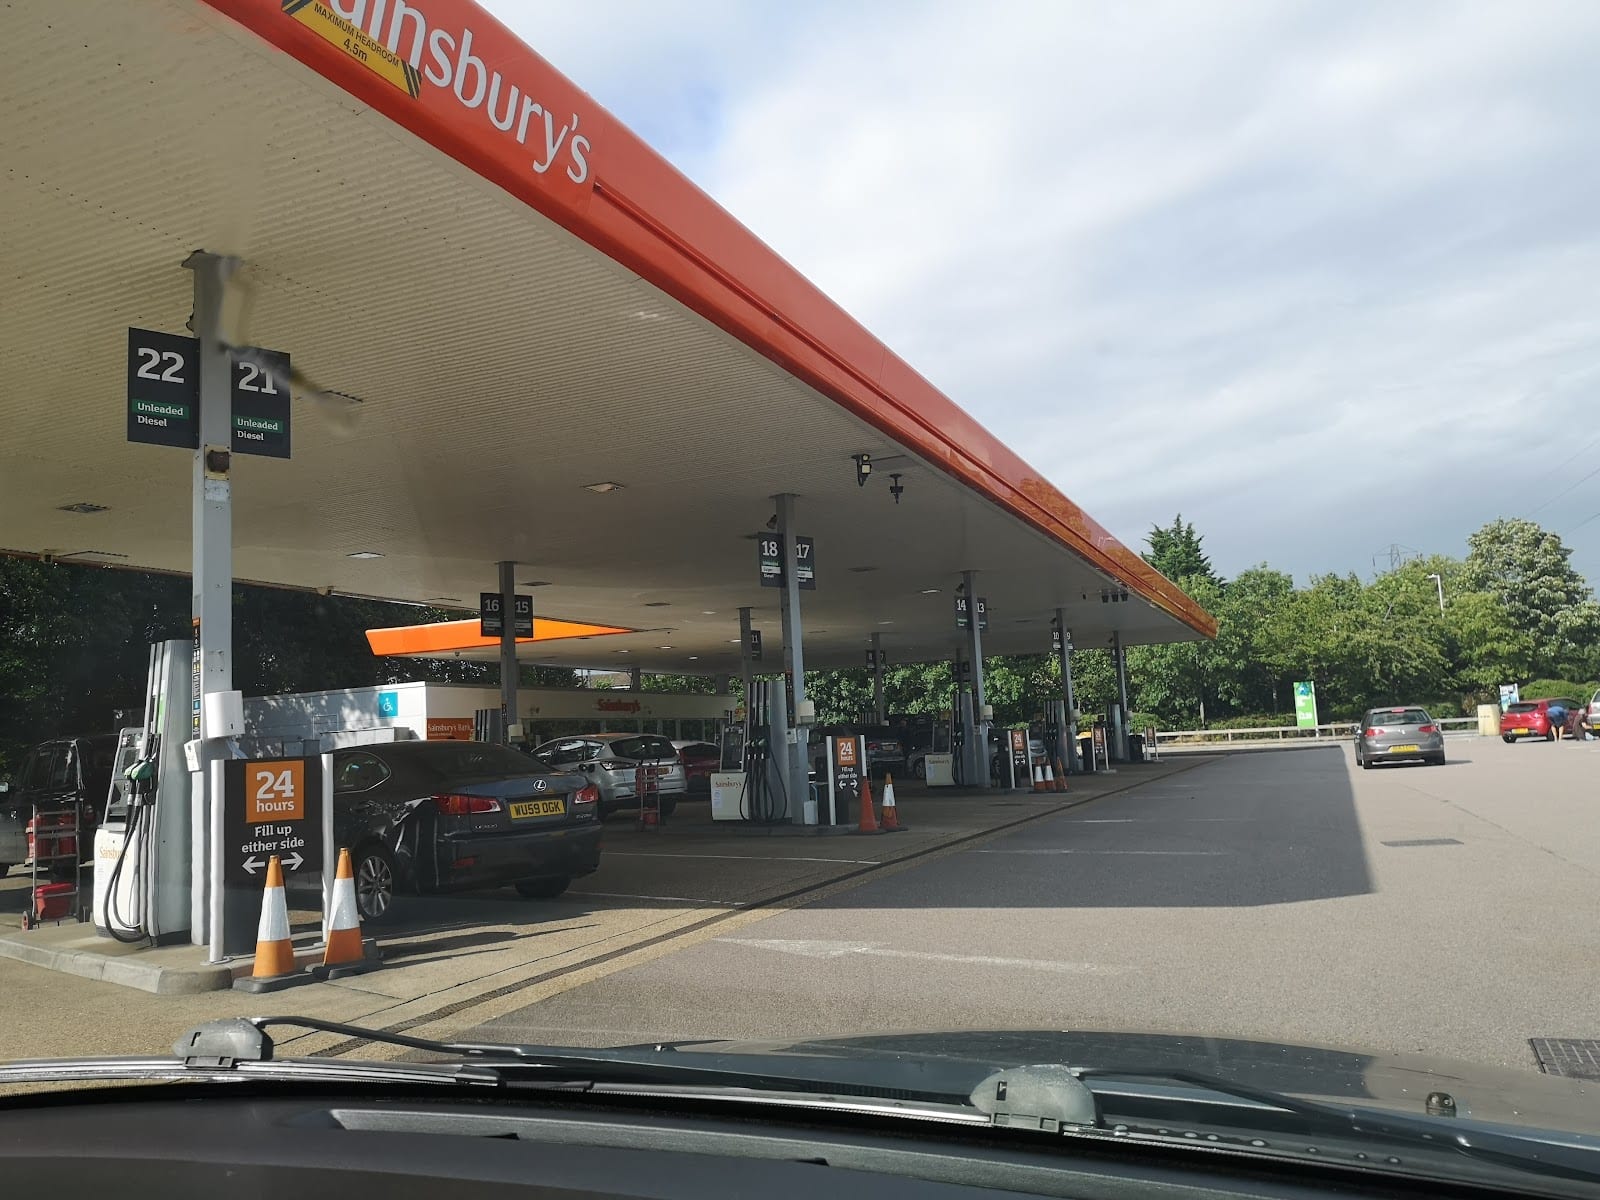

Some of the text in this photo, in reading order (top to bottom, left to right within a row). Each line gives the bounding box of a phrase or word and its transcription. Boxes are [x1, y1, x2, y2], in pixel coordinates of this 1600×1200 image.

[314, 3, 400, 67] MAXIMUM HEADROOM
[343, 38, 368, 62] 4.5m
[137, 347, 185, 384] 22
[238, 361, 278, 395] 21
[137, 402, 184, 416] Unleaded
[137, 415, 167, 427] Diesel
[237, 418, 278, 431] Unleaded
[237, 430, 265, 441] Diesel
[761, 540, 779, 557] 18
[796, 543, 810, 559] 17
[485, 598, 500, 612] 16
[515, 600, 529, 613] 15
[956, 599, 967, 611] 14
[976, 602, 985, 613] 13
[1053, 631, 1060, 640] 10
[840, 742, 853, 755] 24
[256, 769, 295, 799] 24
[256, 799, 295, 813] hours
[514, 803, 541, 816] WU59
[255, 824, 292, 837] Fill up
[241, 836, 305, 853] either side
